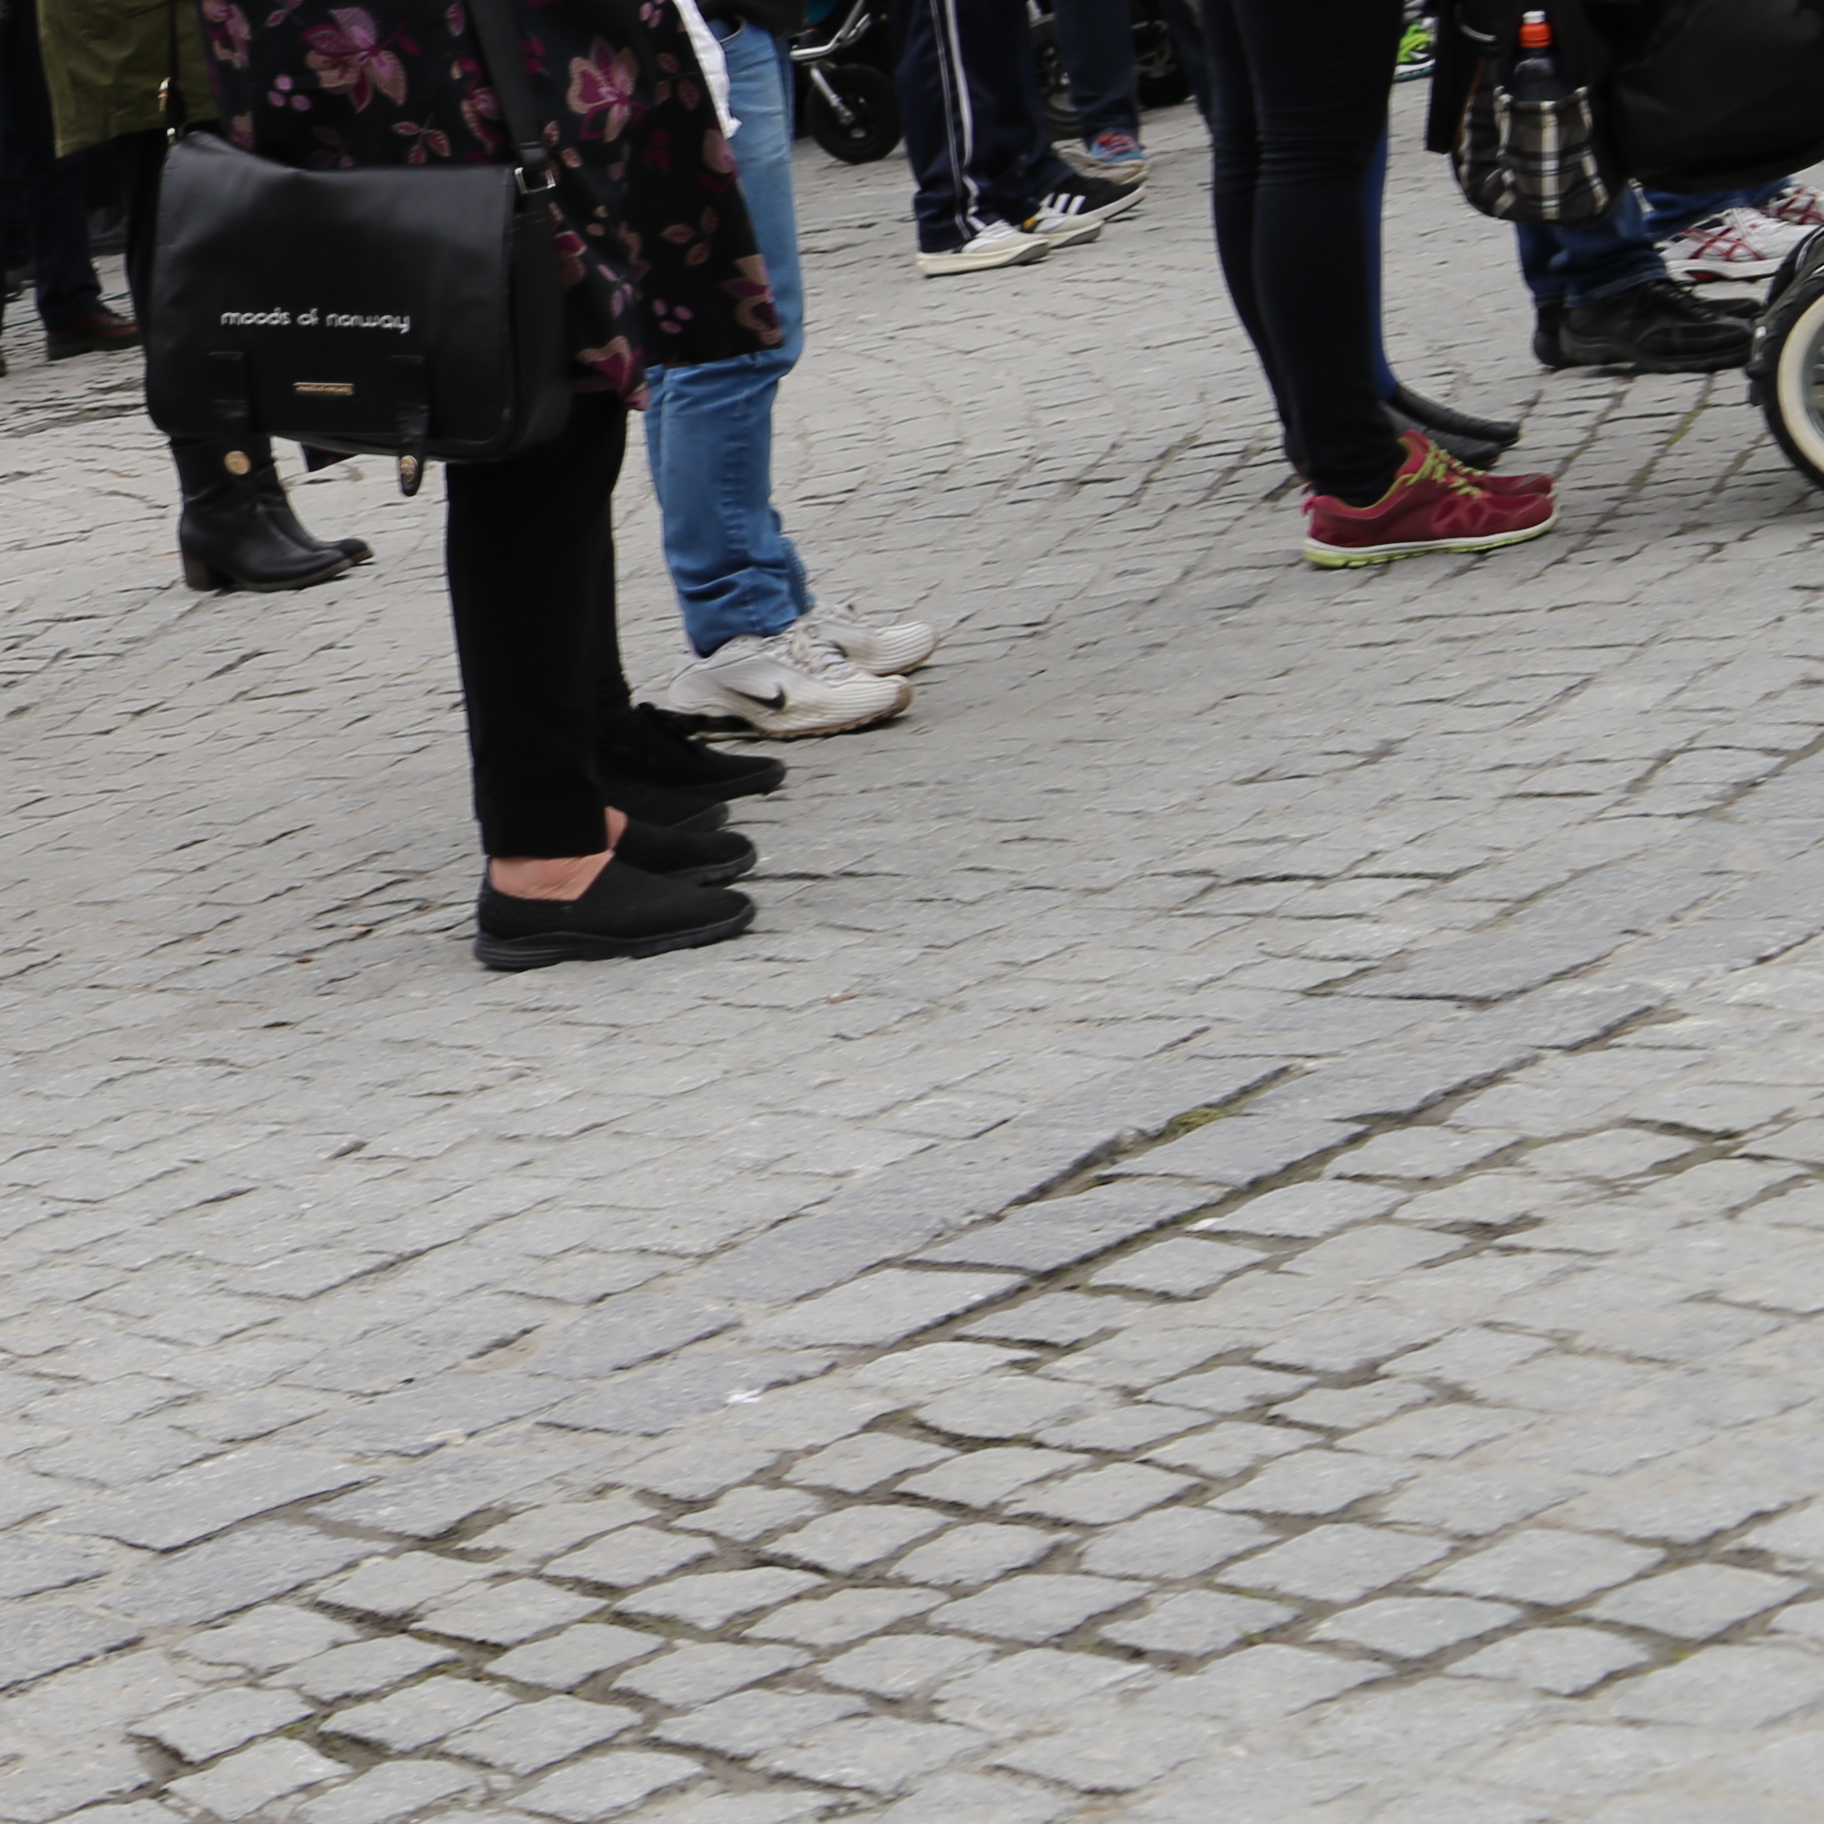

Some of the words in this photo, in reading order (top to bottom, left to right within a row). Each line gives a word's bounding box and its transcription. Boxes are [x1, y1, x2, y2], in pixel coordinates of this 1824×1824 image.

[220, 307, 292, 326] moods
[297, 307, 319, 326] of
[326, 313, 411, 334] norway
